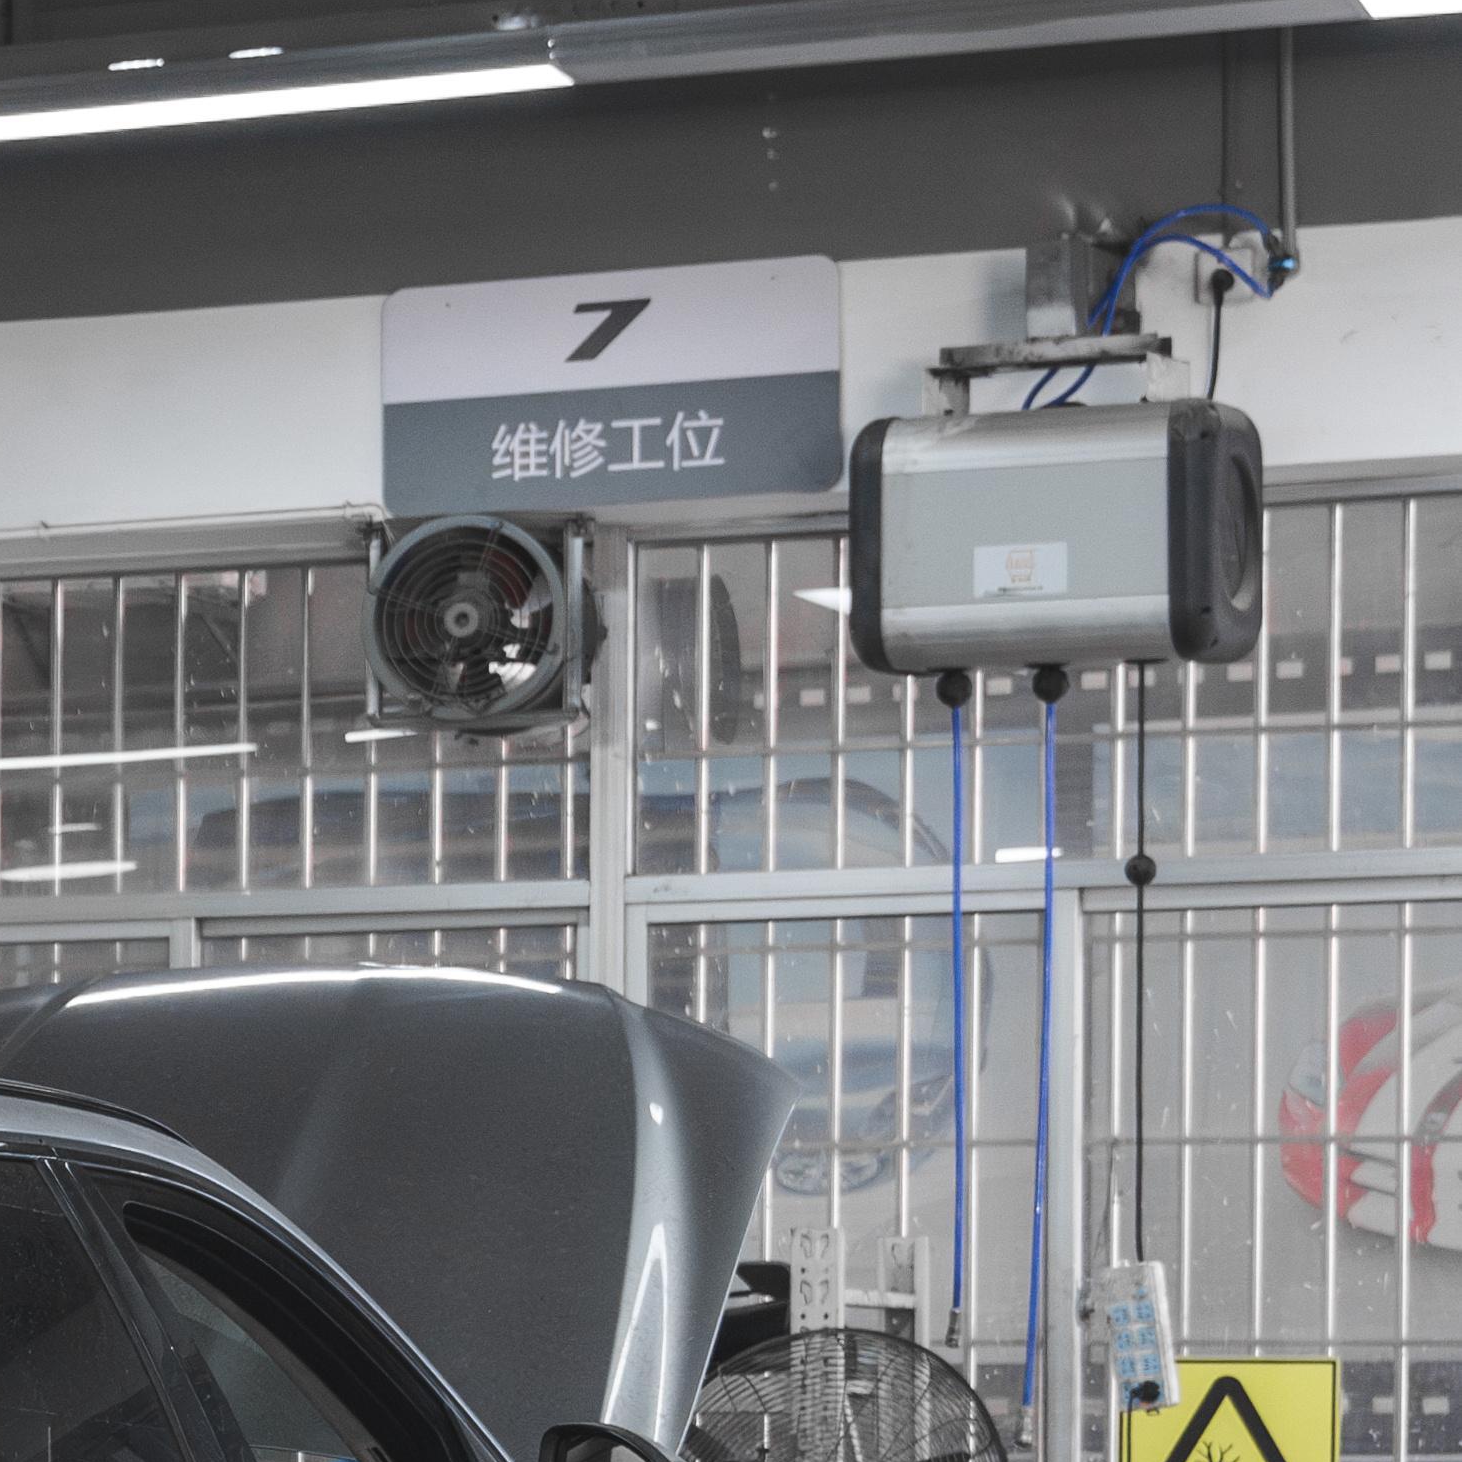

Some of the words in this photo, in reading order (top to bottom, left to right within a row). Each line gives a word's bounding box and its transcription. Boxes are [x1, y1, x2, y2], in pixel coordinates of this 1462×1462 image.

[565, 297, 651, 362] 7
[490, 409, 726, 482] 维修工位
